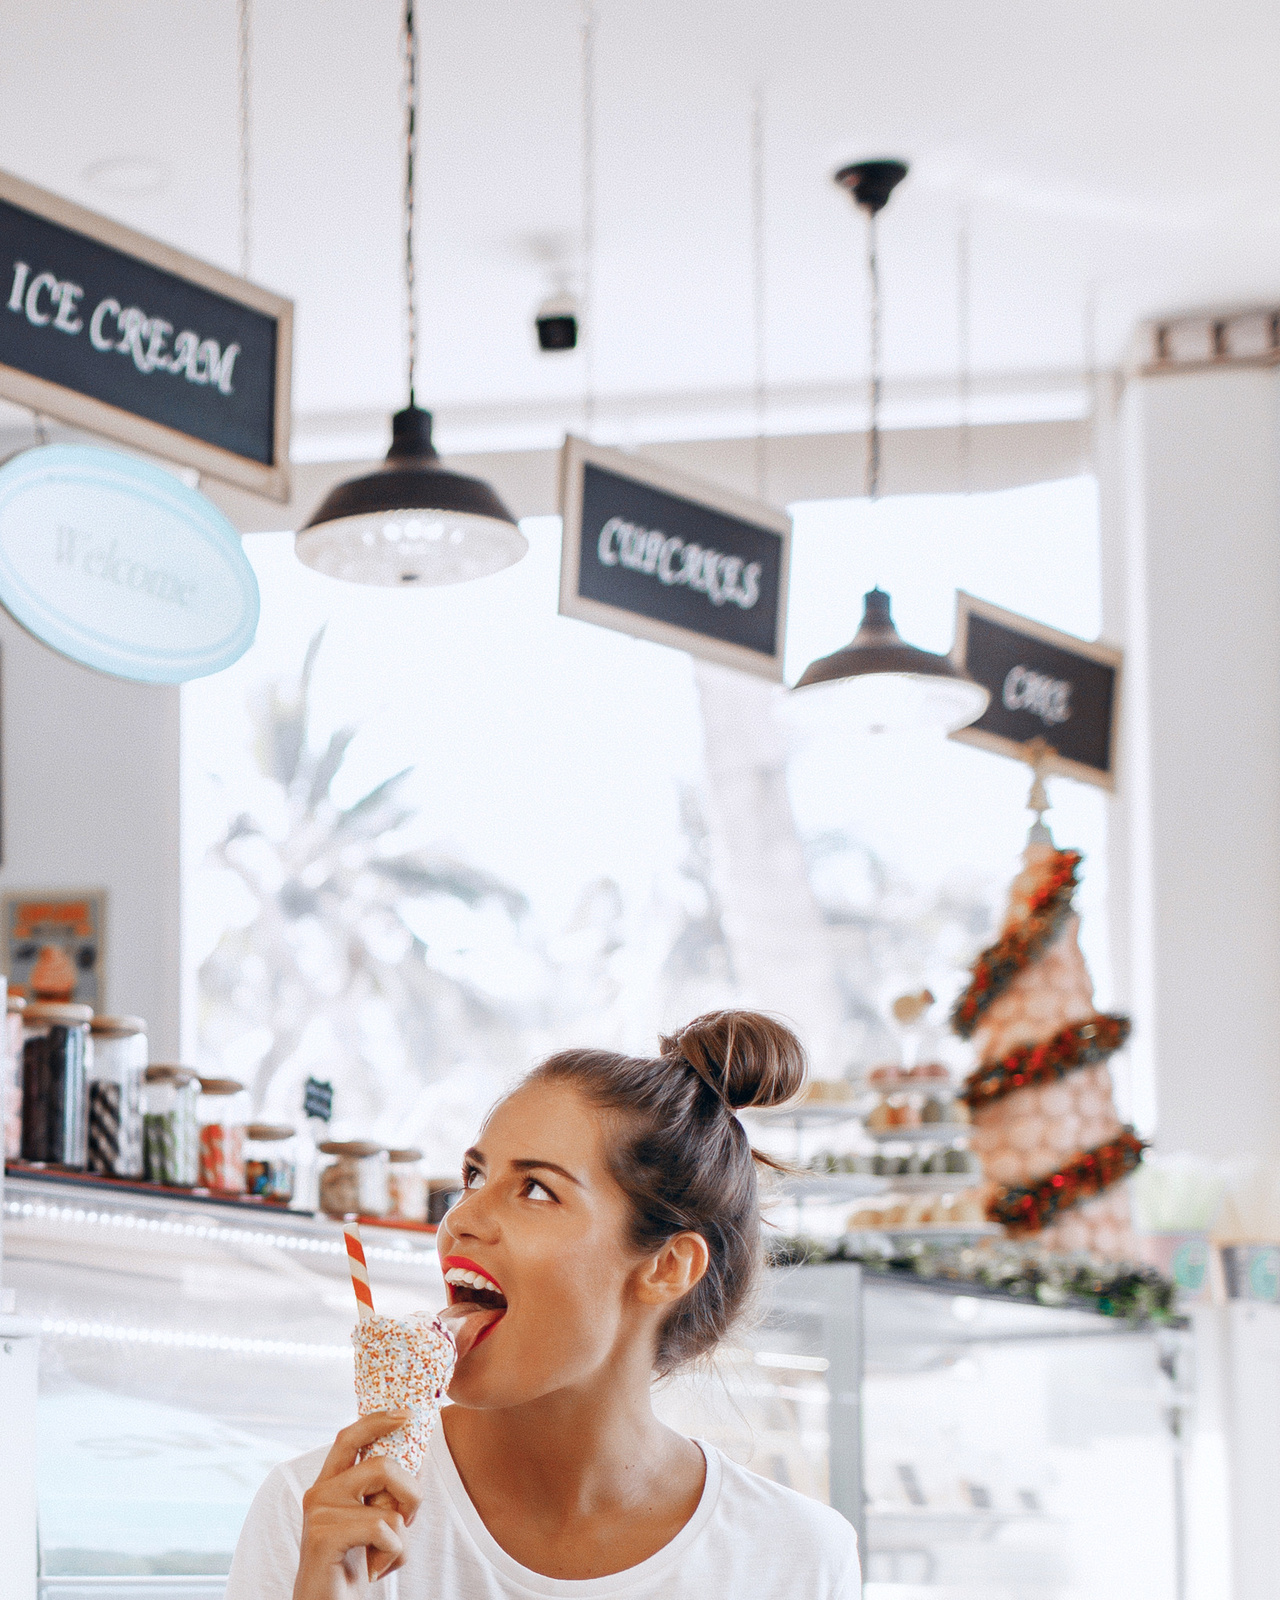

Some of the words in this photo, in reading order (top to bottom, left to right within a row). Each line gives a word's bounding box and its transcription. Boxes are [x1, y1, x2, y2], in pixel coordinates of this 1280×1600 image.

[6, 260, 84, 336] ICE
[88, 297, 241, 396] CREAM
[55, 523, 201, 607] Welcome
[596, 515, 762, 611] CUPCAKES
